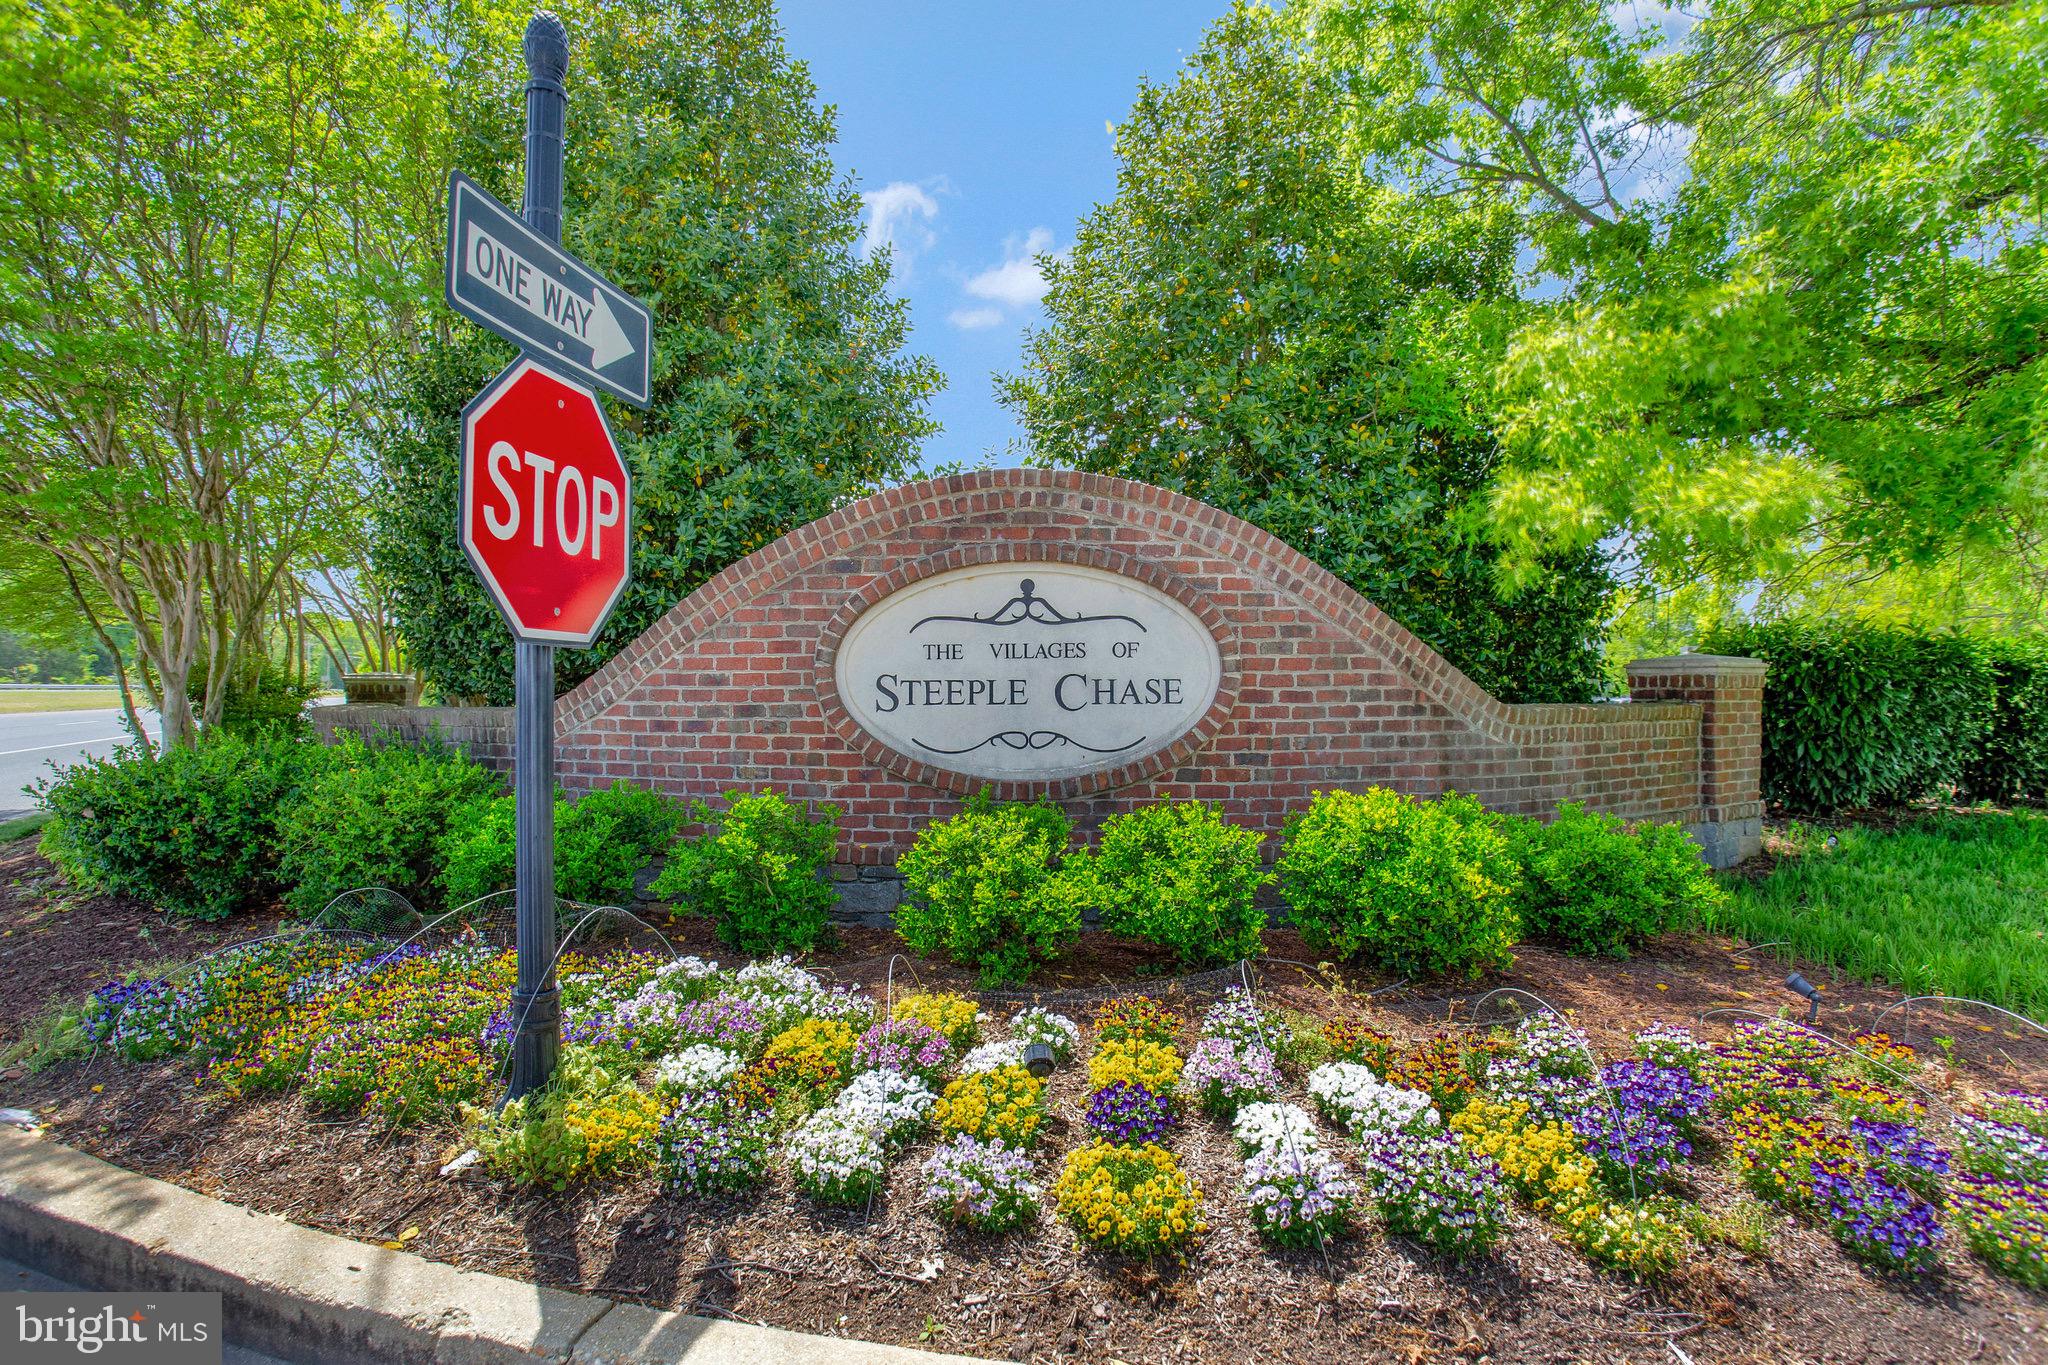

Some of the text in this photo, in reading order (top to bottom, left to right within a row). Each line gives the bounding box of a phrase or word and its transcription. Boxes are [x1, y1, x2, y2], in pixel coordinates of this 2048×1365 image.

[475, 236, 593, 338] ONE WAY
[483, 440, 620, 561] STOP
[923, 641, 1140, 660] THE VILLAGES OF
[875, 673, 1184, 713] STEEPLE CHASE
